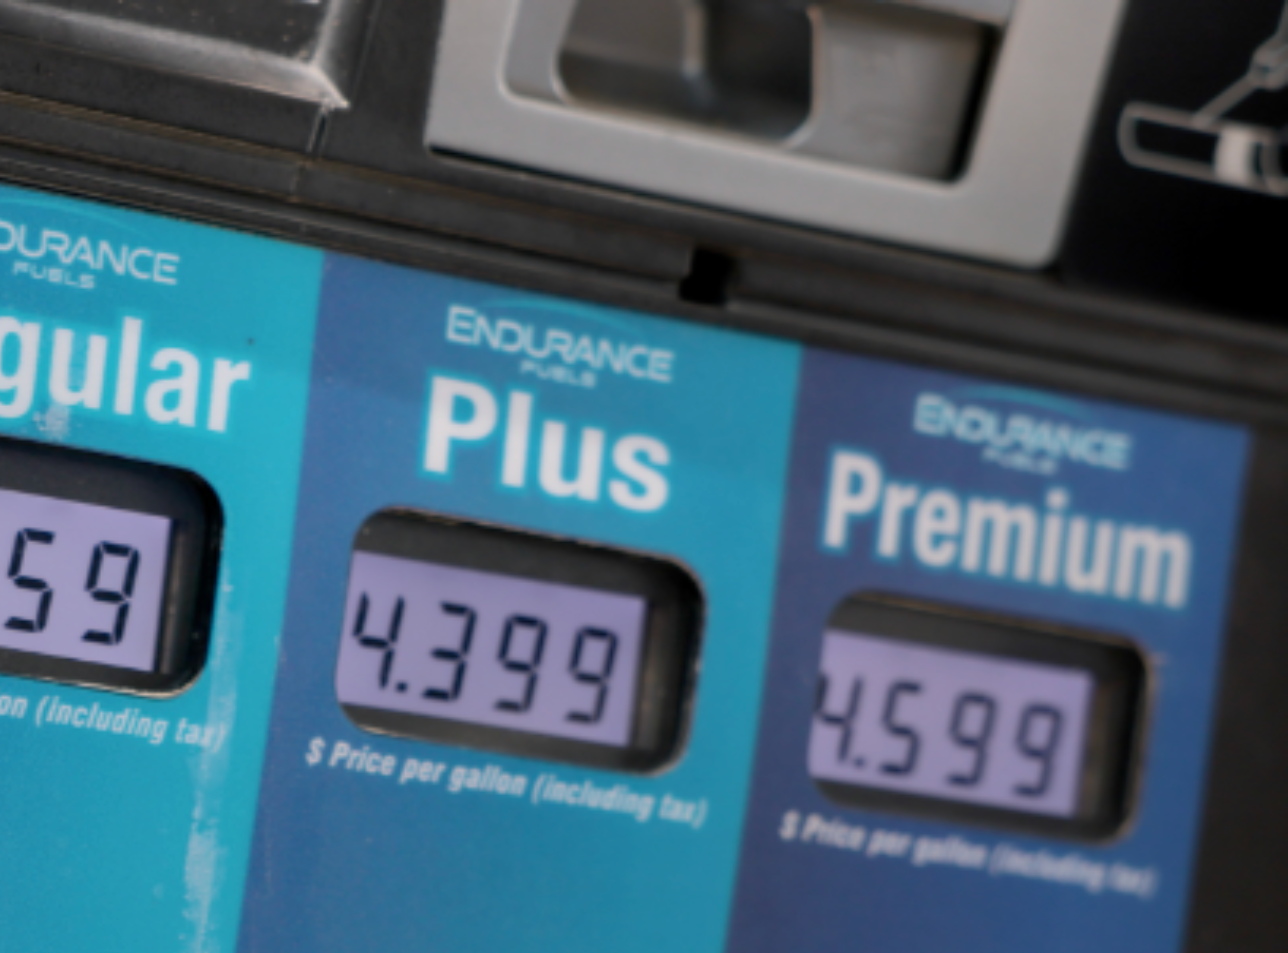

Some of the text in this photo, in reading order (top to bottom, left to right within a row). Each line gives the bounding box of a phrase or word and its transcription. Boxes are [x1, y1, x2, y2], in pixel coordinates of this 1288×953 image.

[12, 261, 95, 289] FUELS
[445, 305, 675, 383] ENDURANCE
[520, 360, 597, 388] FUELS
[423, 375, 671, 513] Plus
[914, 393, 1132, 471] ENDURANCE
[823, 451, 1191, 609] Premium
[352, 592, 618, 723] 4.399
[34, 695, 166, 745] (including
[814, 671, 1064, 798] 4.599
[305, 738, 708, 827] $ Price per gallon (including tax)
[803, 813, 867, 852] Price
[869, 828, 912, 859] per
[915, 834, 987, 867] gallon
